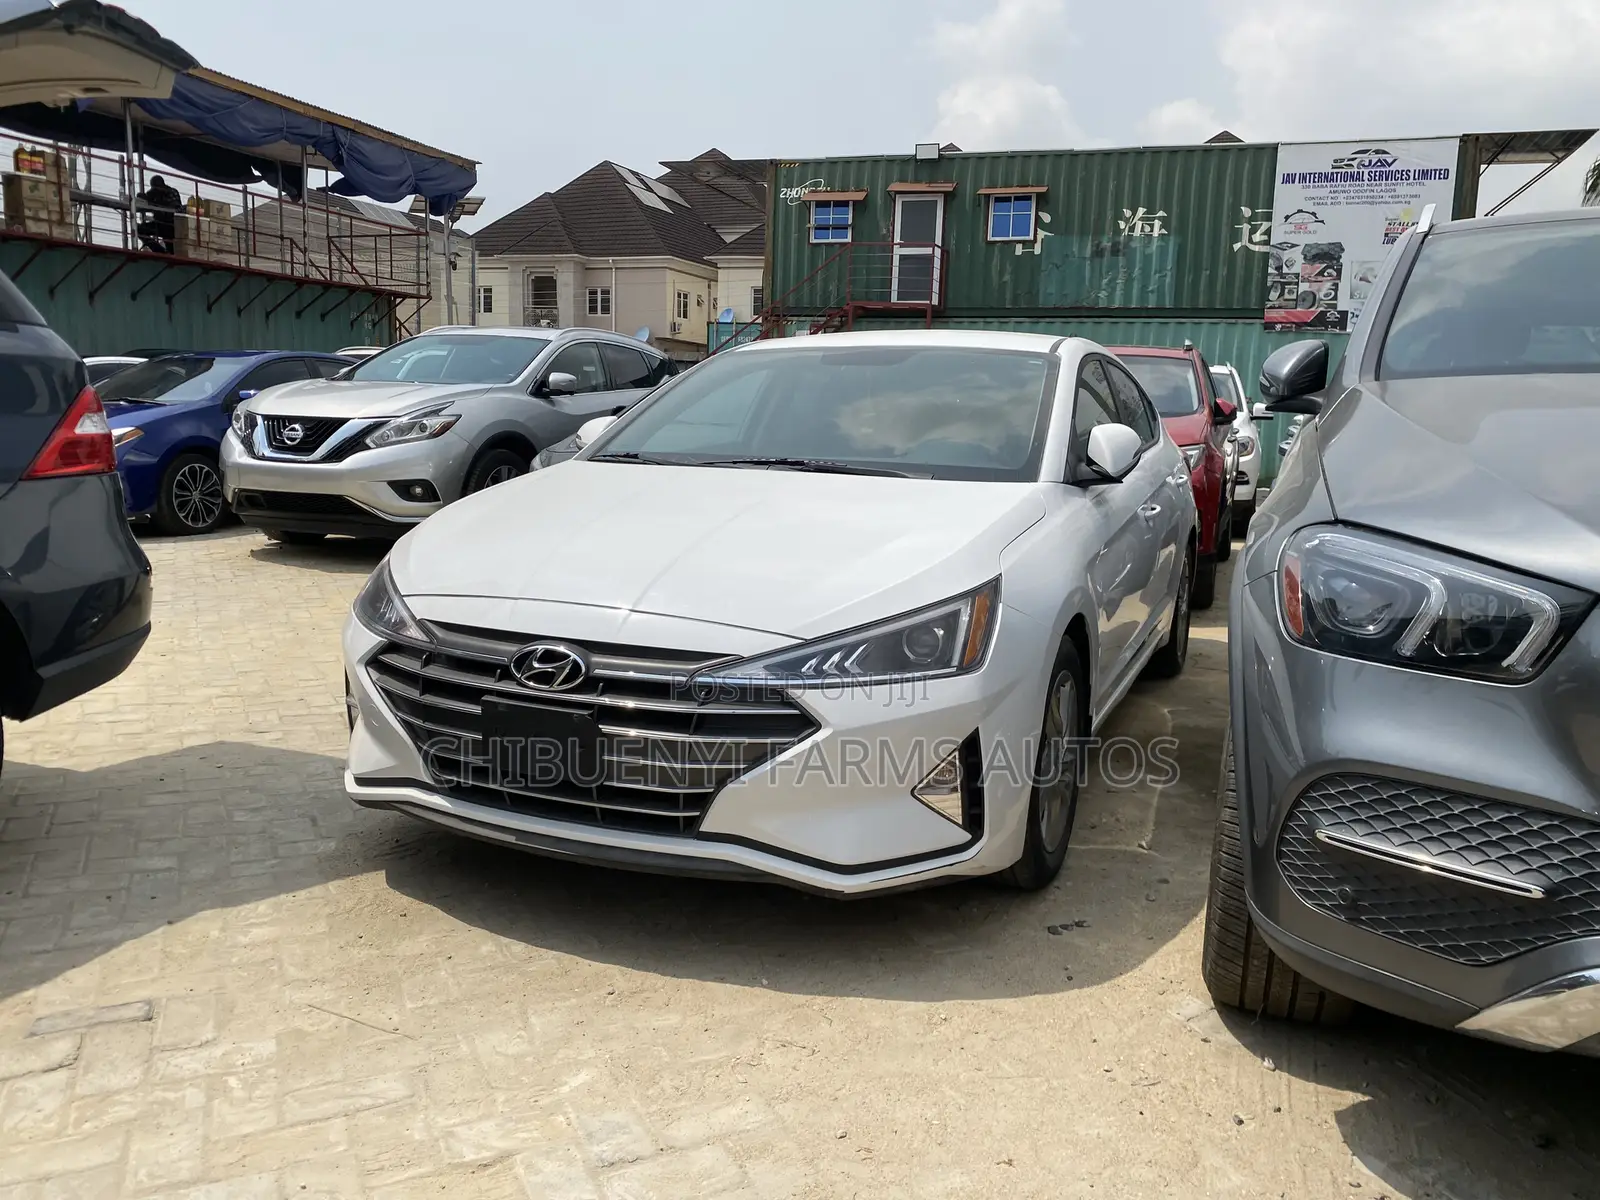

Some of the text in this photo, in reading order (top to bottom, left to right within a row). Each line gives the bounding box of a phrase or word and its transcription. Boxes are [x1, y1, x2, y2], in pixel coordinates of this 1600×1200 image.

[1360, 158, 1399, 169] JAV
[1281, 168, 1450, 185] JAV INTERNATIONAL SERVICES LIMITED
